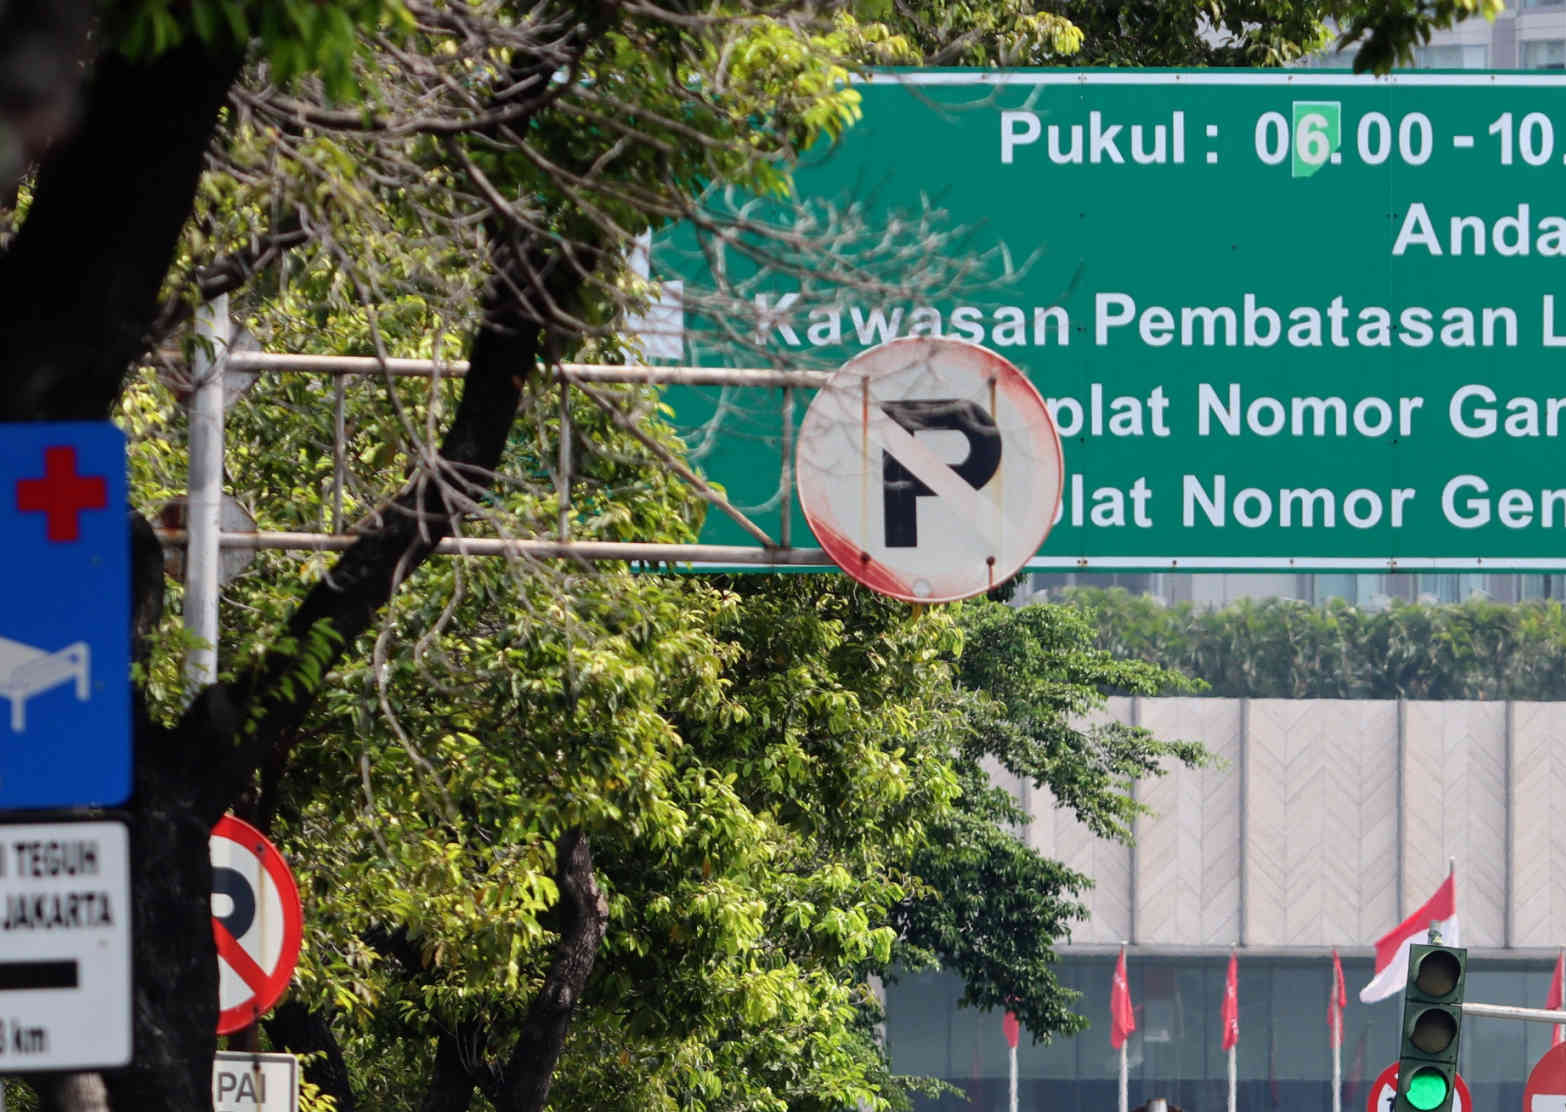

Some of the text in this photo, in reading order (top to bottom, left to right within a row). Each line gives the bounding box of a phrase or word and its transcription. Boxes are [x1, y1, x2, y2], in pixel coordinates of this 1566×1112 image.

[1001, 110, 1184, 164] Pukul
[1256, 107, 1432, 168] 06.00
[755, 291, 1069, 347] Kawasan
[1096, 293, 1517, 346] Pembatasan
[1199, 384, 1424, 436] Nomor
[1062, 473, 1151, 529] lat
[1184, 475, 1415, 528] Nomor
[4, 894, 114, 929] JAKARTA
